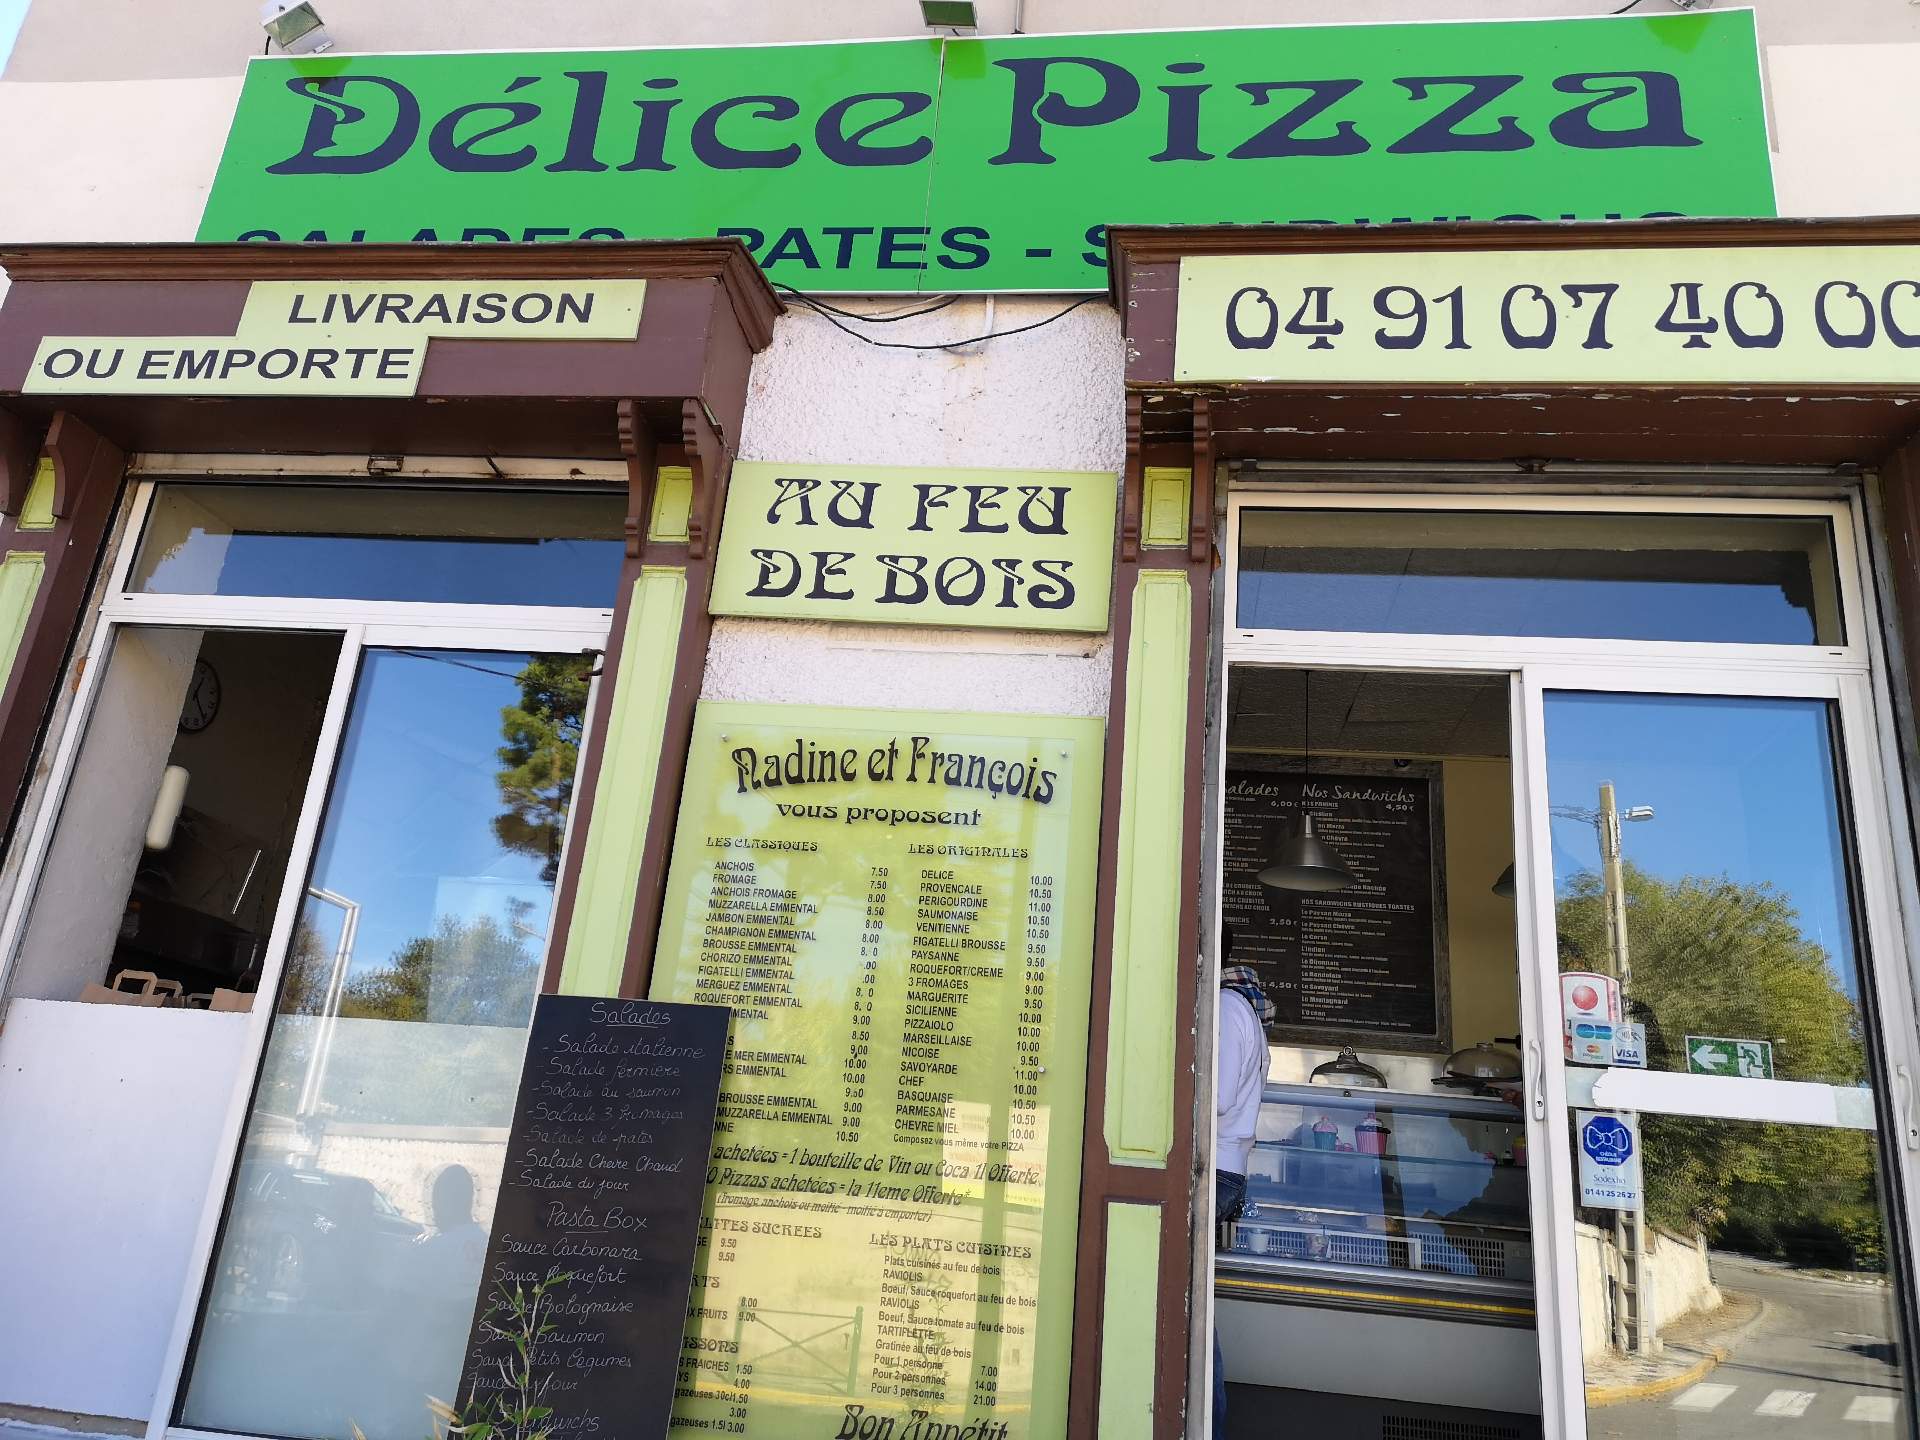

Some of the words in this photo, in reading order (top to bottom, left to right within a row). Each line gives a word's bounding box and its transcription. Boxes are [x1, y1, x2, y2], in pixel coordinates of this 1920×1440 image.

[265, 70, 934, 174] Délice
[988, 56, 1703, 164] Pizza
[288, 292, 595, 325] LIVRAISON
[1226, 286, 1345, 351] 04
[1374, 285, 1473, 350] 91
[1501, 283, 1619, 350] 07
[1655, 281, 1784, 349] 40
[42, 348, 123, 381] OU
[136, 348, 414, 381] EMPORTE
[766, 478, 882, 530] AU
[907, 484, 1072, 536] FEU
[745, 548, 856, 600] DE
[874, 554, 1076, 610] BOIS
[731, 738, 857, 794] Nadine
[867, 736, 899, 782] et
[906, 736, 1057, 804] François
[1301, 783, 1328, 799] Nos
[1332, 785, 1415, 803] Sandwichs
[1385, 803, 1408, 812] 4,50
[775, 803, 837, 820] vous
[845, 807, 982, 827] proposent
[706, 837, 731, 848] LES
[734, 838, 818, 852] CLASSIQUES
[908, 843, 934, 855] LES
[937, 845, 1029, 859] ORIGINALES
[714, 861, 755, 871] ANCHOIS
[712, 874, 757, 884] FROMAGE
[921, 870, 954, 880] DELICE
[710, 886, 751, 898] ANCHOIS
[752, 888, 798, 900] FROMAGE
[920, 883, 983, 894] PROVENCALE
[708, 899, 768, 911] MUZZARELLA
[769, 902, 819, 914] EMMENTAL
[918, 896, 988, 908] PERIGOURDINE
[705, 913, 744, 924] JAMBON
[746, 914, 796, 926] EMMENTAL
[917, 908, 979, 920] SAUMONAISE
[704, 926, 766, 938] CHAMPIGNON
[767, 928, 817, 941] EMMENTAL
[916, 922, 970, 934] VENITIENNE
[702, 939, 746, 950] BROUSSE
[748, 941, 798, 954] EMMENTAL
[913, 936, 958, 948] FIGATELLI
[961, 938, 1006, 950] BROUSSE
[700, 953, 741, 964] CHORIZO
[743, 955, 793, 966] EMMENTAL
[911, 950, 960, 962] PAYSANNE
[698, 966, 744, 978] FIGATELLI
[745, 968, 795, 980] EMMENTAL
[910, 964, 1004, 978] ROQUEFORT/CREME
[696, 979, 740, 990] MERGUEZ
[742, 981, 793, 994] EMMENTAL
[916, 978, 969, 990] FROMAGES
[693, 993, 751, 1005] ROQUEFORT
[752, 996, 803, 1008] EMMENTAL
[906, 990, 969, 1004] MARGUERITE
[589, 1001, 672, 1025] Salades
[905, 1005, 958, 1017] SICILIENNE
[904, 1018, 954, 1031] PIZZAIOLO
[851, 1030, 870, 1041] 8.50
[902, 1033, 972, 1047] MARSEILLAISE
[553, 1033, 619, 1053] Salade
[1016, 1041, 1040, 1052] 10.00
[734, 1050, 754, 1062] MER
[756, 1052, 808, 1065] EMMENTAL
[901, 1046, 940, 1059] NICOISE
[1615, 1048, 1639, 1059] VISA
[545, 1056, 606, 1076] Salade
[1020, 1056, 1039, 1066] 9.50
[735, 1064, 787, 1078] EMMENTAL
[900, 1062, 958, 1075] SAVOYARDE
[842, 1072, 866, 1084] 10.00
[898, 1076, 925, 1087] CHEF
[539, 1080, 593, 1099] Salade
[626, 1086, 681, 1098] saumon
[1014, 1084, 1038, 1096] 10.00
[719, 1092, 765, 1106] BROUSSE
[766, 1096, 818, 1109] EMMENTAL
[897, 1090, 954, 1104] BASQUAISE
[532, 1102, 596, 1121] Salade
[843, 1102, 863, 1113] 9.00
[896, 1105, 956, 1118] PARMESANE
[1012, 1099, 1036, 1110] 10.50
[716, 1106, 779, 1122] MUZZARELLA
[781, 1112, 833, 1125] EMMENTAL
[894, 1120, 934, 1132] CHEVRE
[936, 1122, 960, 1134] MIEL
[893, 1134, 934, 1146] Composez
[1001, 1142, 1025, 1152] PIZZA
[520, 1148, 583, 1169] Salade
[635, 1156, 683, 1173] Chaud
[713, 1144, 779, 1164] achetées
[800, 1148, 862, 1170] bouteille
[935, 1160, 970, 1179] Coca
[514, 1169, 574, 1189] Salade
[594, 1180, 630, 1200] jour
[718, 1168, 770, 1189] Pizzas
[770, 1174, 838, 1195] achetées
[546, 1200, 600, 1228] Pasta
[603, 1206, 648, 1232] Box
[752, 1222, 822, 1239] SUCREES
[497, 1233, 549, 1255] Sauce
[552, 1237, 643, 1261] Carbonara
[902, 1235, 953, 1252] PLATS
[956, 1242, 1032, 1259] CUISINES
[494, 1261, 538, 1283] Sauce
[884, 1256, 905, 1266] Plats
[982, 1265, 1000, 1276] bois
[882, 1269, 923, 1282] RAVIOLIS
[880, 1297, 920, 1310] RAVIOLIS
[910, 1286, 936, 1298] Sauce
[937, 1289, 977, 1302] roquefort
[1018, 1296, 1037, 1308] bois
[698, 1308, 728, 1320] FRUITS
[877, 1324, 935, 1340] TARTIFLETTE
[1006, 1324, 1024, 1336] bois
[954, 1347, 972, 1359] bois
[686, 1358, 730, 1372] FRAICHES
[874, 1354, 896, 1365] Pour
[903, 1360, 943, 1371] personne
[872, 1368, 894, 1380] Pour
[902, 1374, 946, 1386] personnes
[981, 1366, 998, 1377] 7.00
[870, 1382, 892, 1394] Pour
[900, 1388, 945, 1402] personnes
[975, 1380, 998, 1392] 14.00
[674, 1388, 714, 1400] gazeuses
[974, 1395, 996, 1407] 21.00
[729, 1408, 747, 1419] 3.00
[670, 1417, 709, 1430] gazeuses
[835, 1404, 894, 1440] Bon
